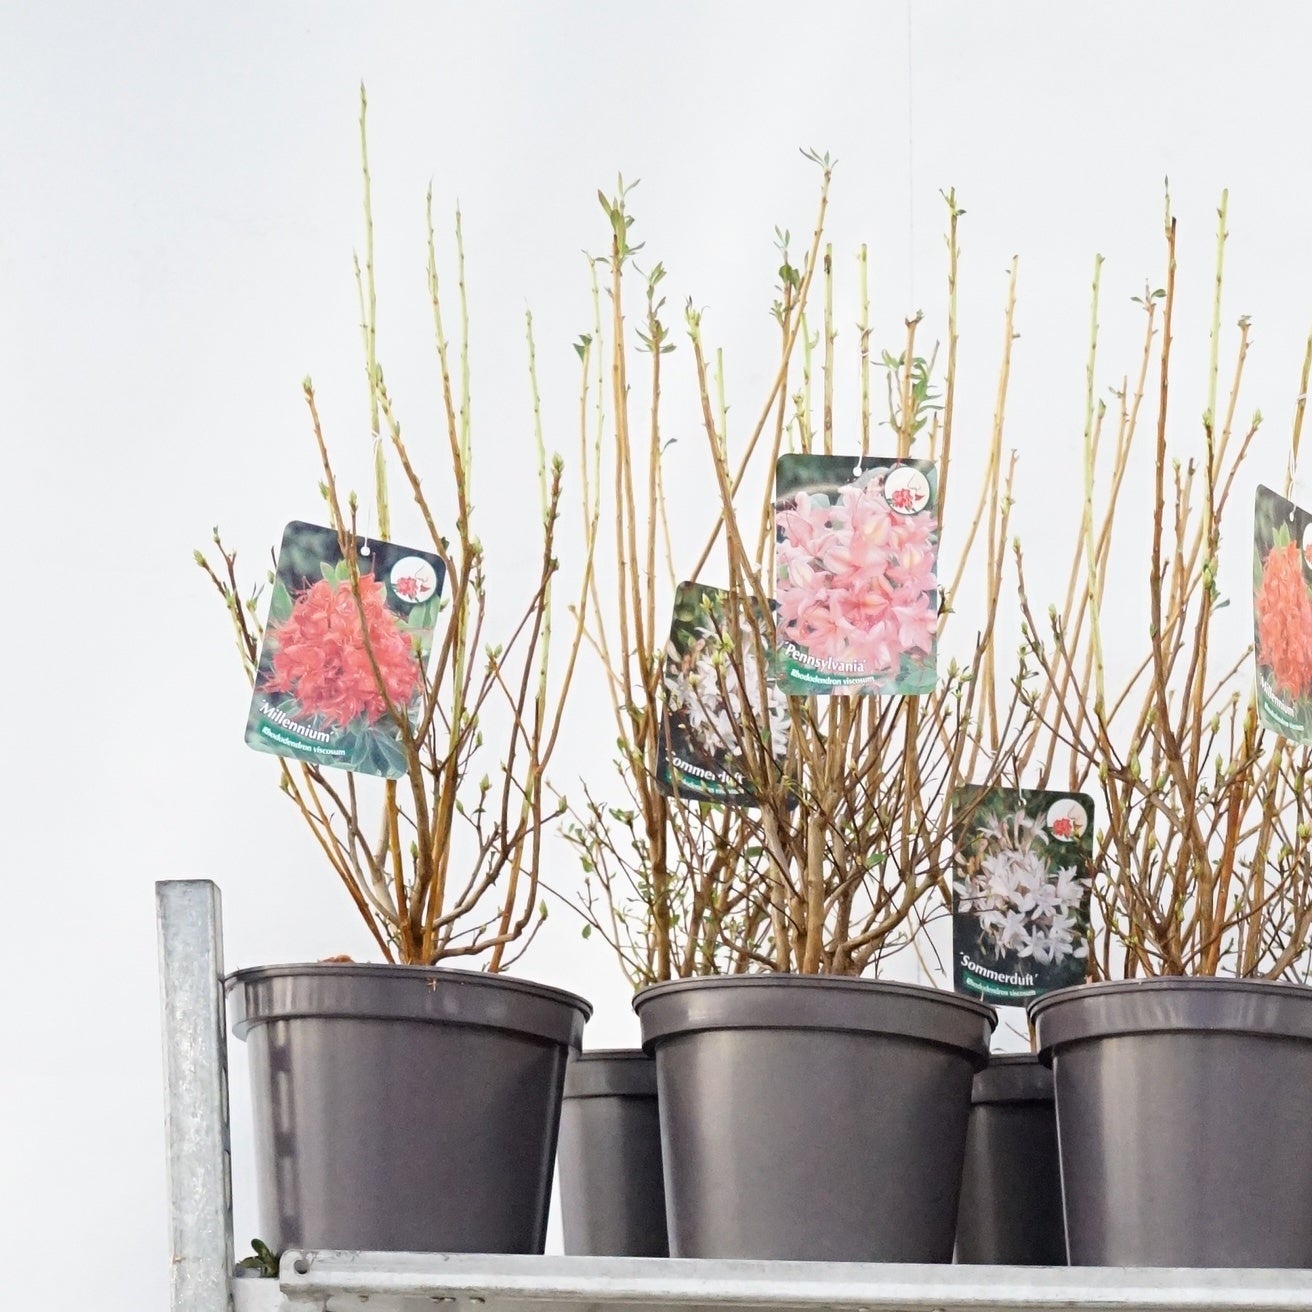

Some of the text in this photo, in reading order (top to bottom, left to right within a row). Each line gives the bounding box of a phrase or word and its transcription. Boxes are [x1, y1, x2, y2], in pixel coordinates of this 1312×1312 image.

[784, 641, 866, 673] 'Pennsylvania'
[259, 699, 334, 743] 'Millennium'
[960, 951, 1038, 986] 'Sommerduft'
